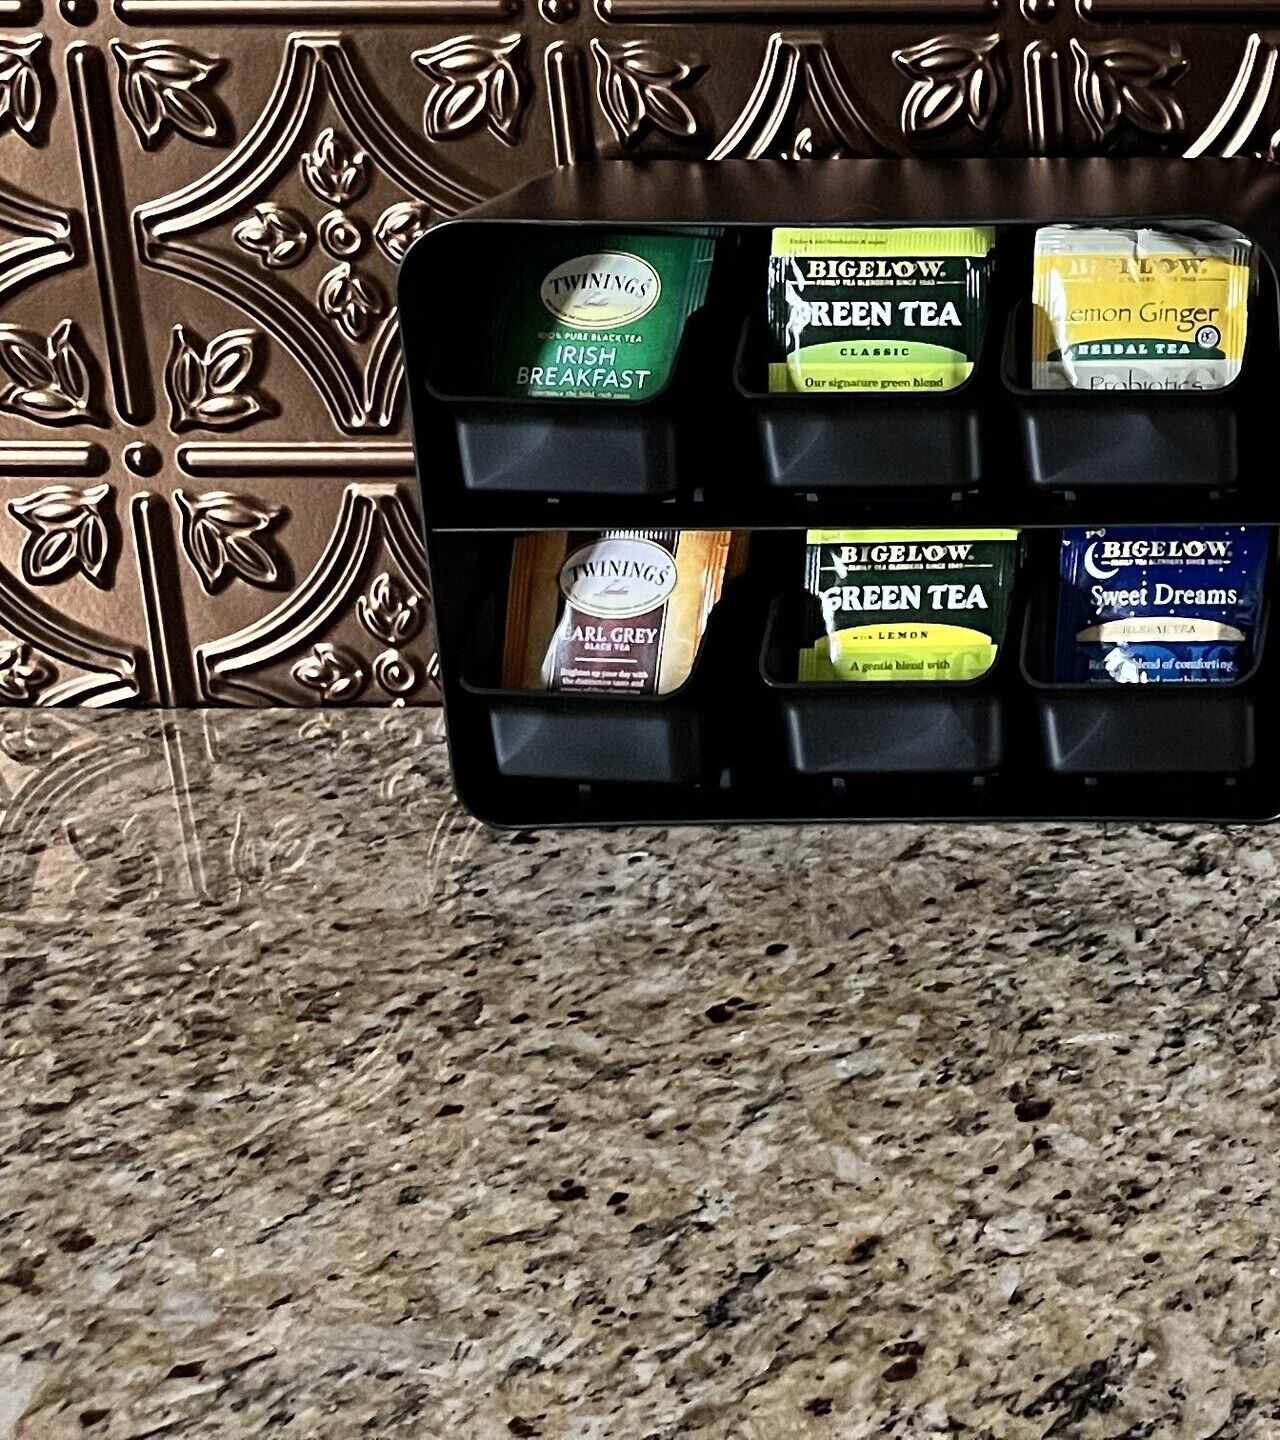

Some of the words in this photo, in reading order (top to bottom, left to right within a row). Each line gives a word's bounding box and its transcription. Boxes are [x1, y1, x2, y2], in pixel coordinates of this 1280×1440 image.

[807, 260, 945, 278] BIGELOW
[549, 272, 650, 299] TWININGS
[898, 300, 962, 327] TEA
[1139, 300, 1219, 333] Ginger
[591, 333, 621, 343] BLACK
[624, 334, 642, 343] TEA
[555, 345, 616, 366] IRISH
[840, 348, 909, 356] CLASSIC
[1078, 343, 1148, 355] HERBAL
[1155, 343, 1190, 355] TEA
[516, 366, 651, 390] BREAKFAST
[805, 377, 826, 388] Our
[829, 378, 878, 390] signature
[881, 379, 910, 390] green
[913, 377, 943, 388] blend
[1090, 369, 1203, 390] Probiotics
[840, 544, 973, 564] BIGELOW
[1101, 540, 1233, 558] BIGELOW
[568, 560, 668, 586] TWININGS
[821, 585, 921, 610] GREEN
[927, 584, 988, 610] TEA
[1091, 584, 1148, 606] Sweet
[1154, 583, 1237, 605] Dreams
[610, 626, 657, 644] GREY
[878, 631, 929, 640] LEMON
[849, 661, 859, 672] A
[927, 660, 951, 670] with
[1175, 658, 1234, 672] comforting
